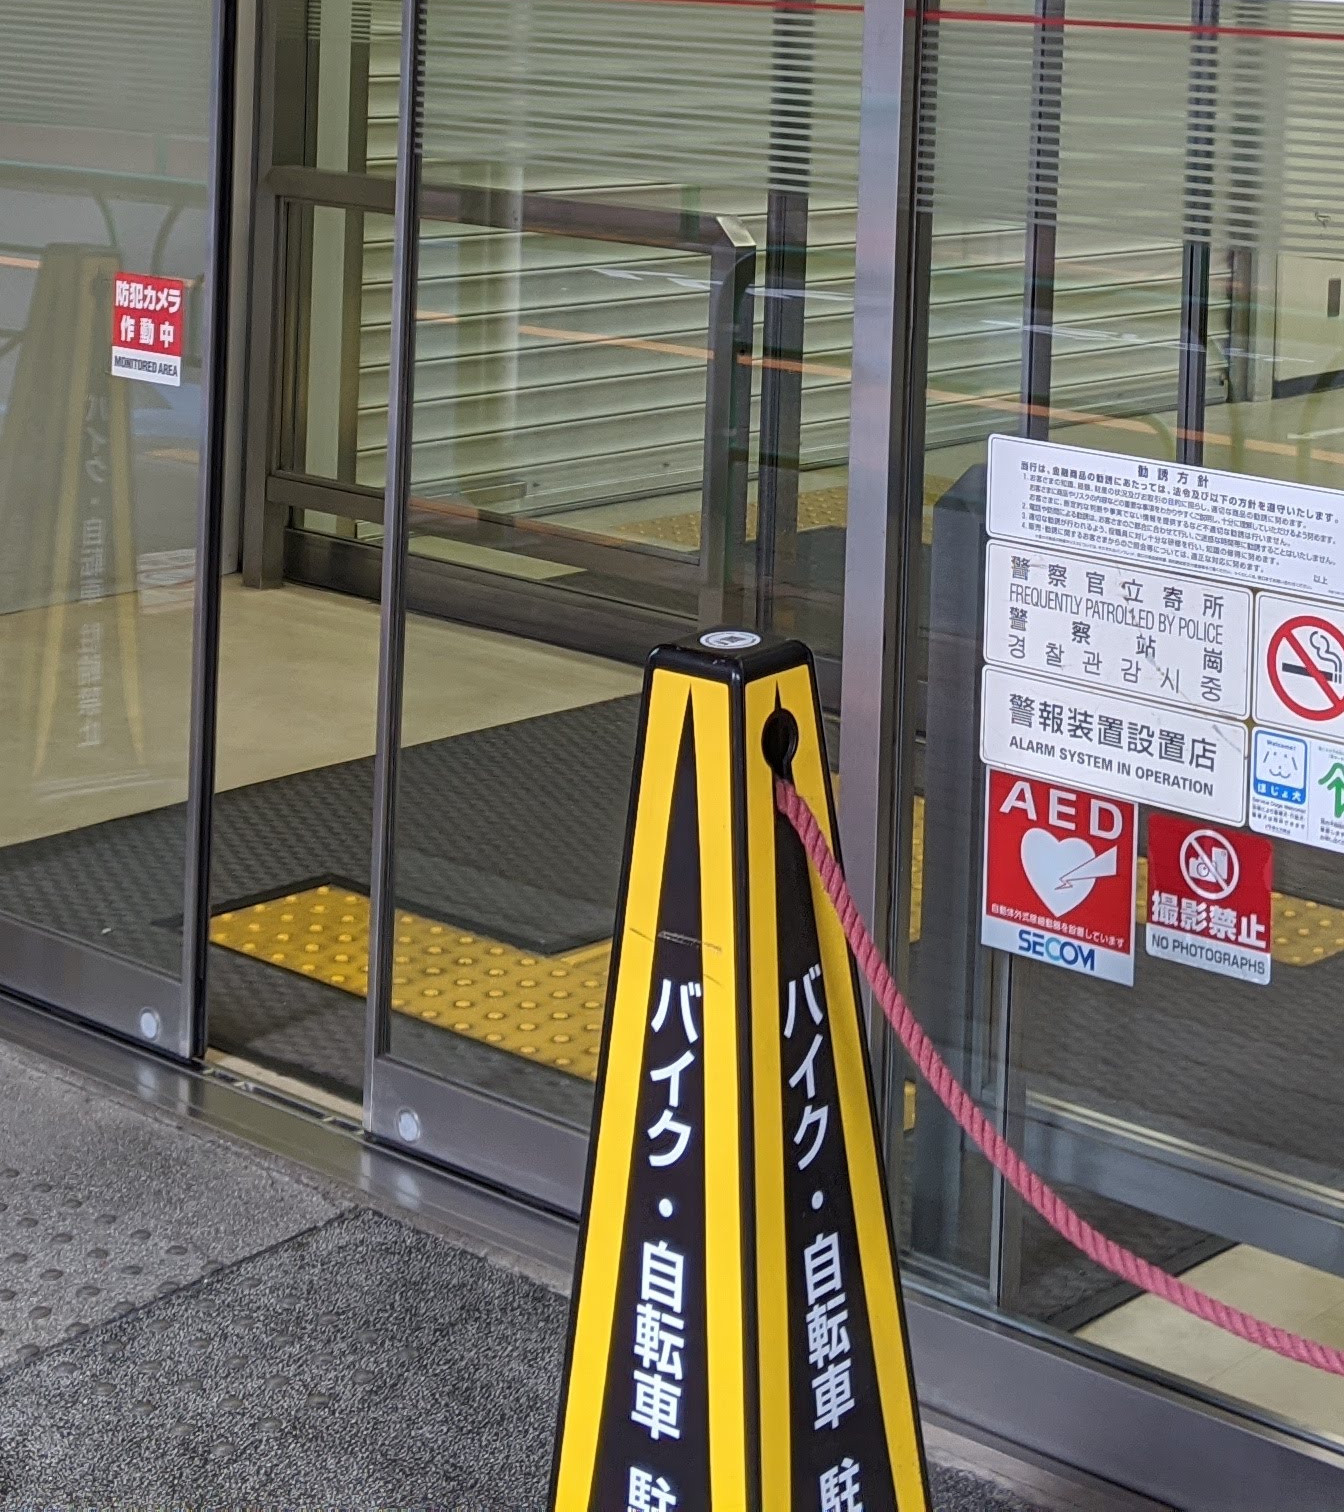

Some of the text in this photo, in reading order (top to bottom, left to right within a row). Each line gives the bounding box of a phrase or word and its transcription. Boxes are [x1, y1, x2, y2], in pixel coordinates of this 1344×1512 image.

[115, 279, 181, 314] 防犯カメラ
[120, 314, 175, 348] 作動中
[114, 355, 178, 377] MONITORED AREA
[1138, 464, 1209, 489] 勧誘方針
[1011, 555, 1225, 620] 警察官立寄所
[1313, 574, 1329, 586] 以上
[1009, 582, 1224, 646] FREQUENTLY PATROLLED BY POLICE
[1009, 693, 1217, 773] 警報装置設置店
[1009, 736, 1214, 797] ALARM SYSTEM IN OPERATION
[1000, 780, 1124, 840] AED
[991, 902, 1125, 948] 自動体外式除細動器を設置しています
[1151, 891, 1267, 949] 撮影禁止
[1018, 929, 1095, 972] SECOM
[1151, 934, 1265, 975] NO PHOTOGRAPHS
[631, 979, 702, 1440] バイク・自転車
[784, 963, 855, 1430] バイク・自転車
